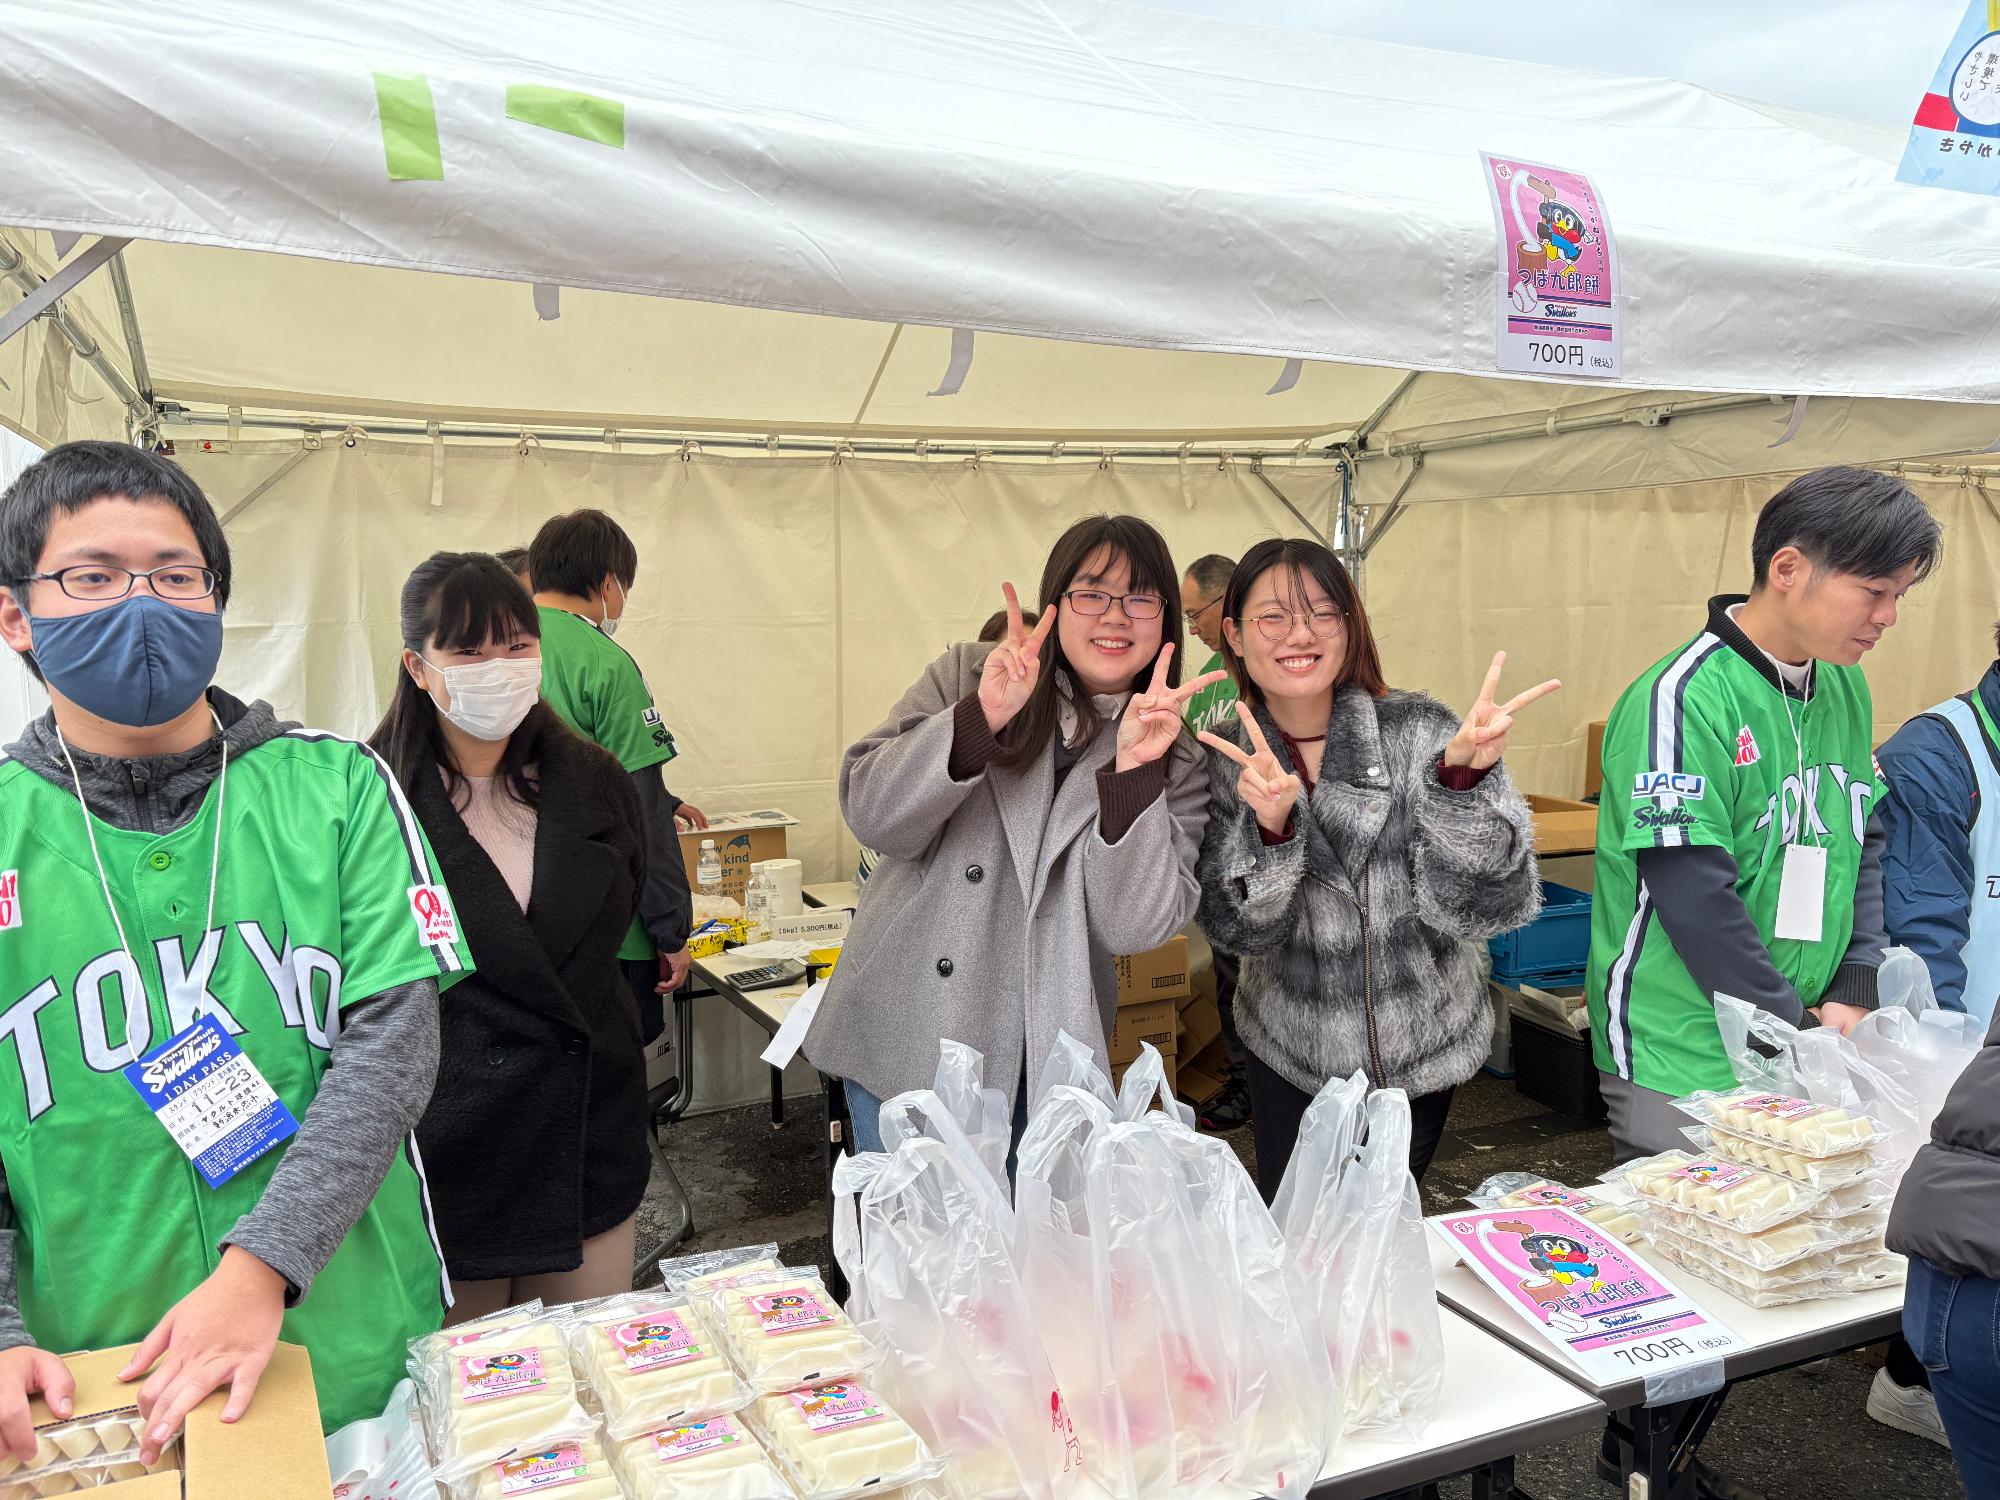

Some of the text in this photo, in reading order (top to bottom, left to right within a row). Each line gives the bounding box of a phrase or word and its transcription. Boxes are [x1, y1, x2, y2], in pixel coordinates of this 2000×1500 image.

[1545, 304, 1577, 317] Swallows
[1529, 343, 1583, 366] 700円
[1192, 699, 1236, 733] TOK
[1634, 773, 1702, 794] UACJ
[724, 852, 749, 865] kind
[0, 920, 342, 1124] TOKYO
[142, 1034, 221, 1093] Swallows
[172, 1073, 200, 1095] DAY
[201, 1051, 232, 1075] PASS
[1598, 1313, 1643, 1328] Swallows
[1613, 1337, 1694, 1366] 700円
